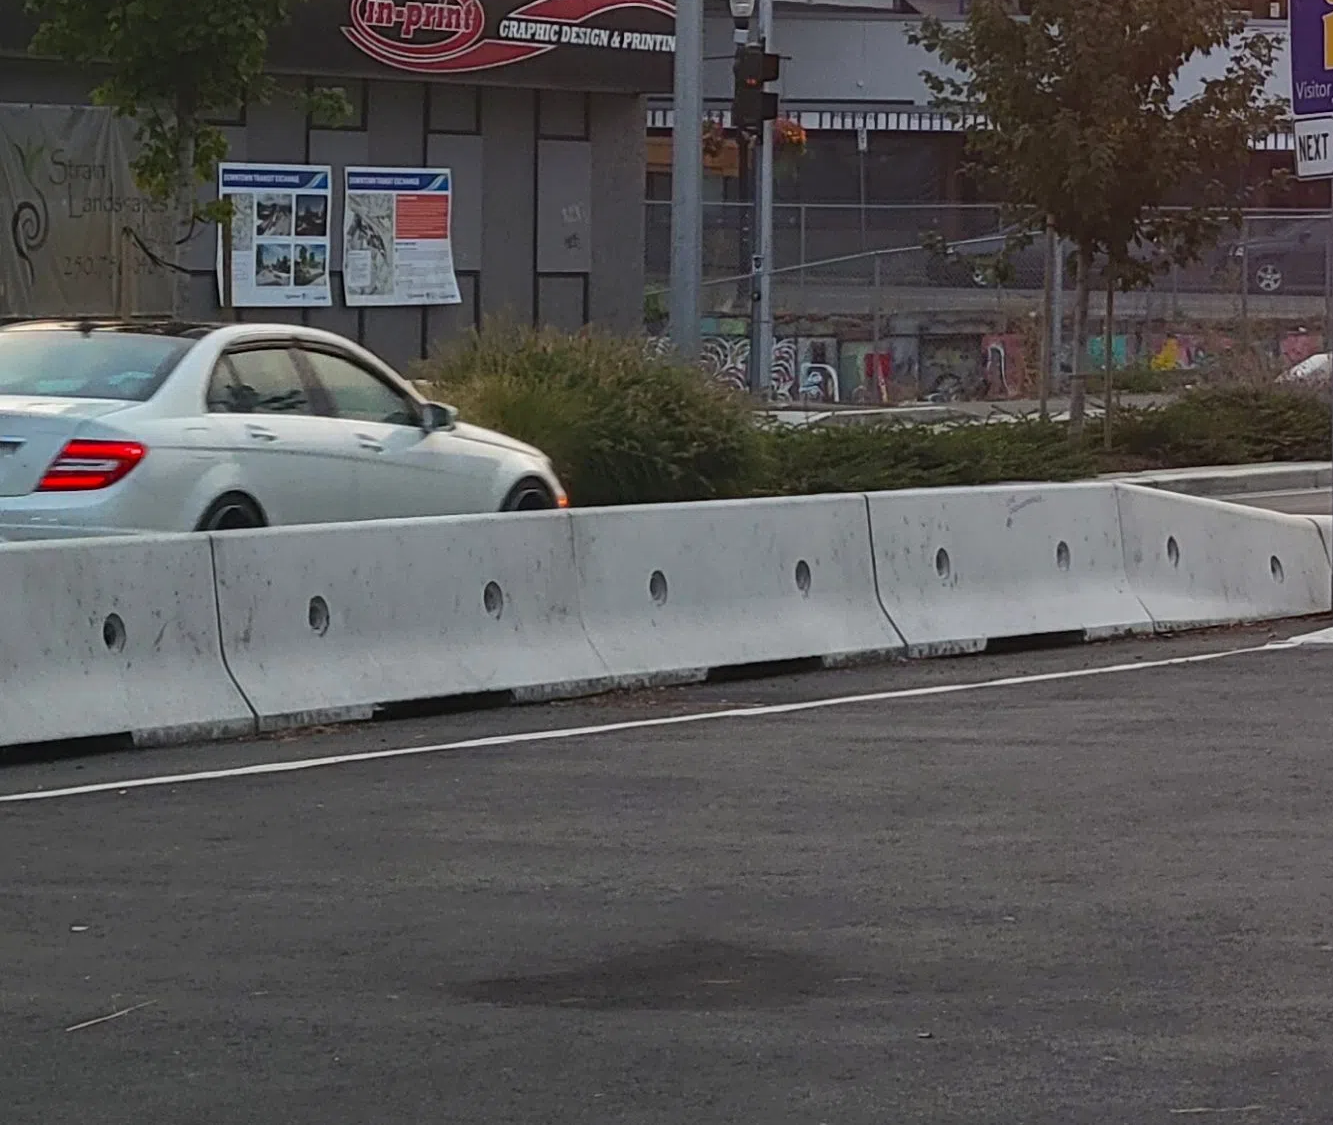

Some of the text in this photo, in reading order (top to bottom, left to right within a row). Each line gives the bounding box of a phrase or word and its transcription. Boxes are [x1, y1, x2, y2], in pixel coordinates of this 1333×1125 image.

[500, 19, 676, 53] GRAPHIC DESIGN & PRINTIN
[1295, 82, 1331, 100] Visitor
[1299, 133, 1329, 162] NEXT
